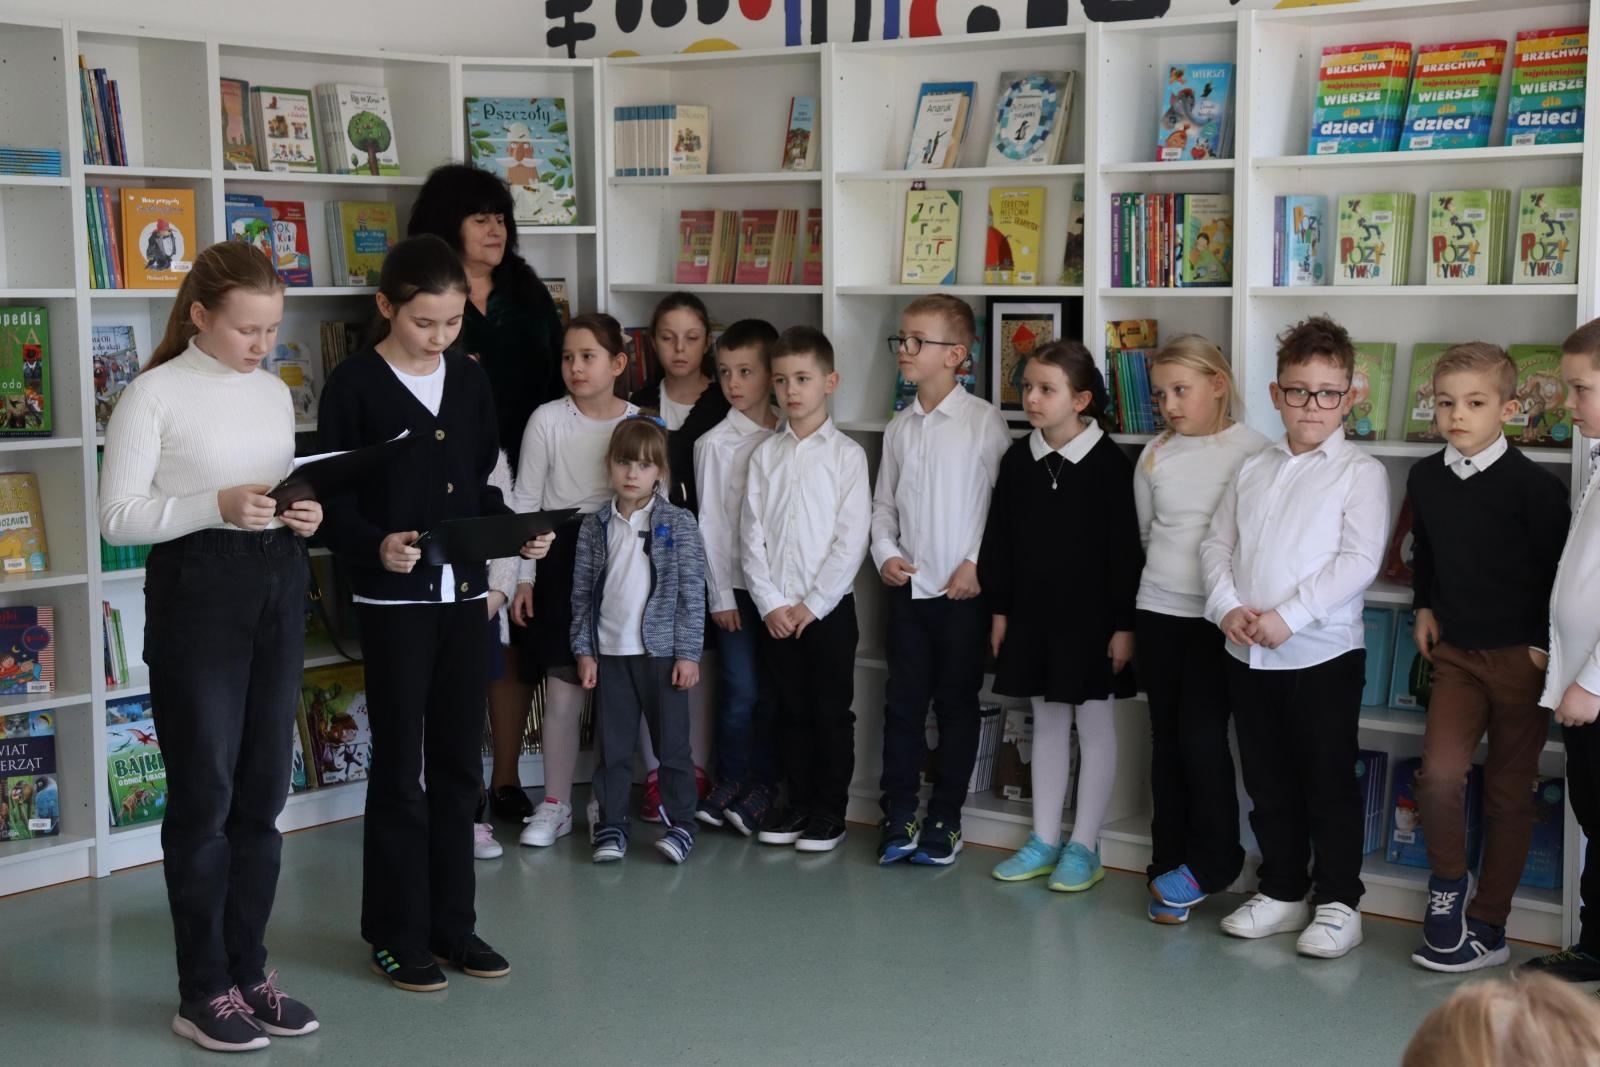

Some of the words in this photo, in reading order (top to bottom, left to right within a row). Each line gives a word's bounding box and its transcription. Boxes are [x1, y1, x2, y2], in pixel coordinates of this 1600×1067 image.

[1561, 37, 1581, 46] Jan
[1521, 47, 1588, 62] BRZECHWA
[1326, 61, 1386, 75] BRZECHWA
[1422, 59, 1487, 73] BRZECHWA
[1519, 78, 1584, 95] WIERSZE
[1324, 90, 1381, 106] WIERSZE
[1418, 87, 1480, 103] WIERSZE
[1541, 96, 1562, 108] dla
[483, 103, 551, 126] Pszczoły
[1437, 104, 1457, 115] dla
[1413, 116, 1471, 131] dzieci
[1517, 109, 1578, 126] dzieci
[1320, 120, 1375, 135] dzieci
[0, 311, 41, 327] pedia
[0, 757, 43, 772] ERZĄT
[114, 751, 166, 779] BAJKI
